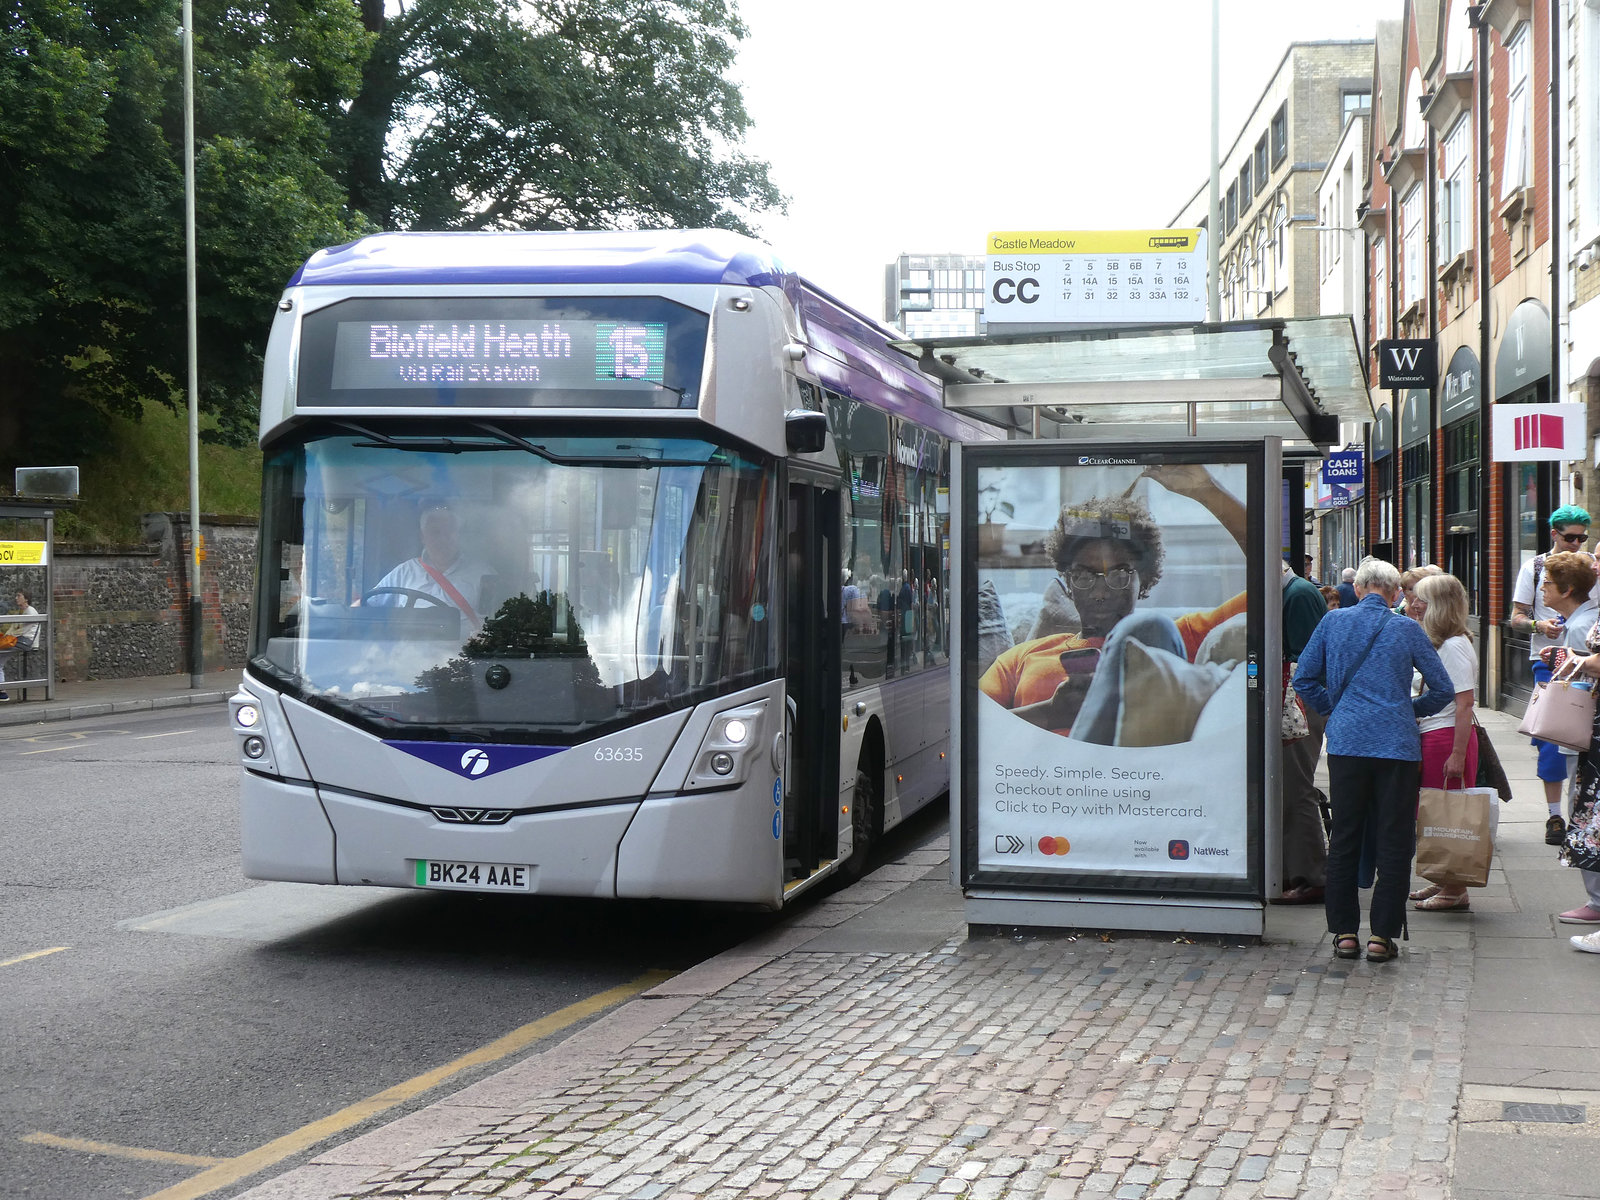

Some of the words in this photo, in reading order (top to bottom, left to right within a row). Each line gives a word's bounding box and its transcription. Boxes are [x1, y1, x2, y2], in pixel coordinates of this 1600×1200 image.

[993, 238, 1028, 249] Castle
[1029, 237, 1076, 249] Meadow
[993, 260, 1014, 271] Bus
[1015, 260, 1041, 272] Stop
[1106, 262, 1119, 270] 5B
[1130, 262, 1142, 270] 6B
[1108, 277, 1118, 285] 15
[1174, 276, 1189, 284] 16A
[992, 277, 1040, 304] CC
[1062, 292, 1072, 300] 17
[1084, 292, 1094, 300] 31
[1106, 292, 1118, 300] 32
[1129, 292, 1141, 300] 33
[370, 324, 476, 358] Blofield
[484, 324, 572, 358] Heath
[608, 326, 649, 378] 15
[1389, 347, 1424, 371] W
[399, 363, 427, 381] via
[431, 363, 464, 381] Rail
[468, 363, 541, 381] Station
[1328, 459, 1357, 468] CASH
[3, 550, 14, 561] CV
[594, 747, 643, 762] 63635
[995, 764, 1049, 781] Speedy.
[1053, 766, 1106, 782] Simple.
[1111, 767, 1165, 781] Secure.
[995, 782, 1062, 797] Checkout
[1066, 785, 1108, 798] online
[1113, 787, 1151, 801] using
[995, 800, 1029, 813] Click
[1032, 802, 1048, 814] to
[1052, 802, 1078, 817] Pay
[1082, 803, 1114, 816] with
[1118, 804, 1207, 818] Mastercard.
[1432, 832, 1481, 841] WAREHOUSE
[1433, 826, 1474, 835] MOUNTAIN
[1193, 847, 1229, 856] NatWest
[429, 863, 480, 884] BK24
[487, 866, 525, 886] AAE
